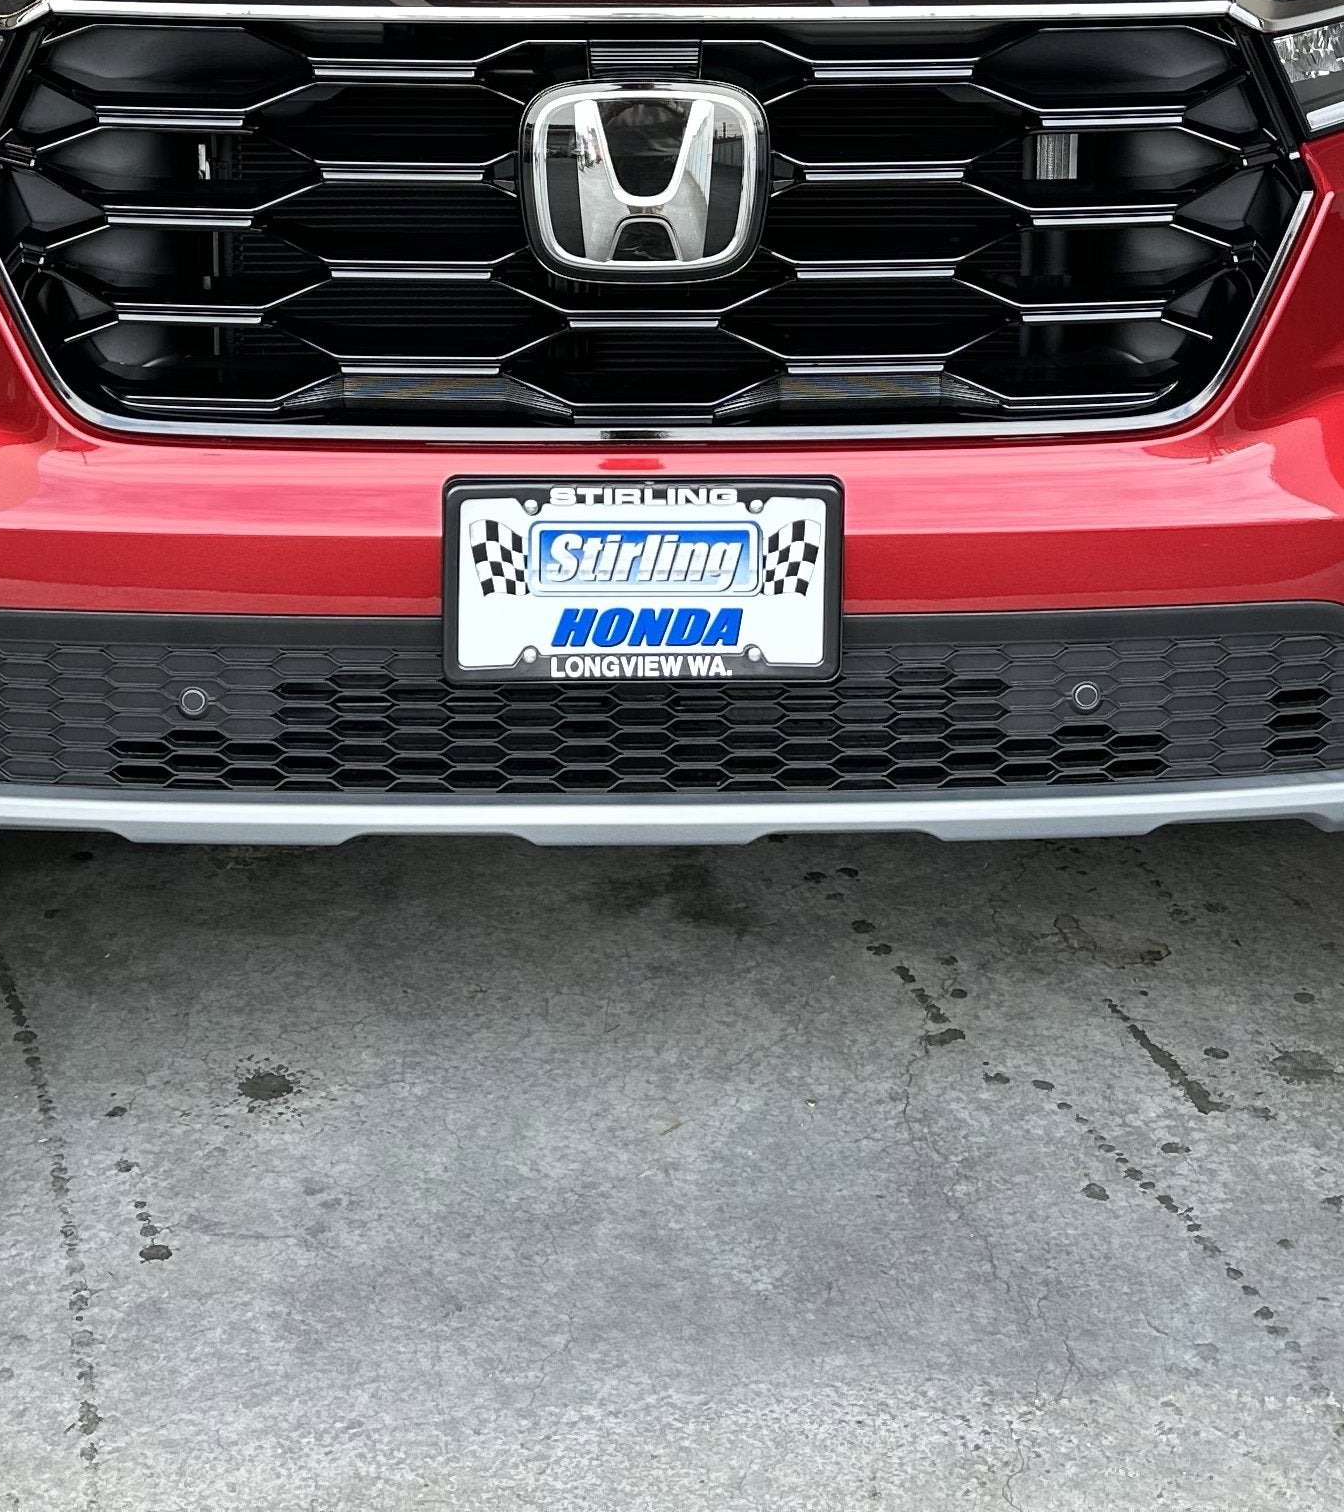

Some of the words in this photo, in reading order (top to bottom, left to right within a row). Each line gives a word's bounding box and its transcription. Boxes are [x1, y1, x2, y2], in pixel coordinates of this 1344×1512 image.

[550, 486, 738, 506] STIRLING
[545, 533, 744, 592] Stirling
[551, 607, 744, 647] HONDA
[550, 656, 683, 678] LONGVIEW
[687, 655, 733, 677] WA.
